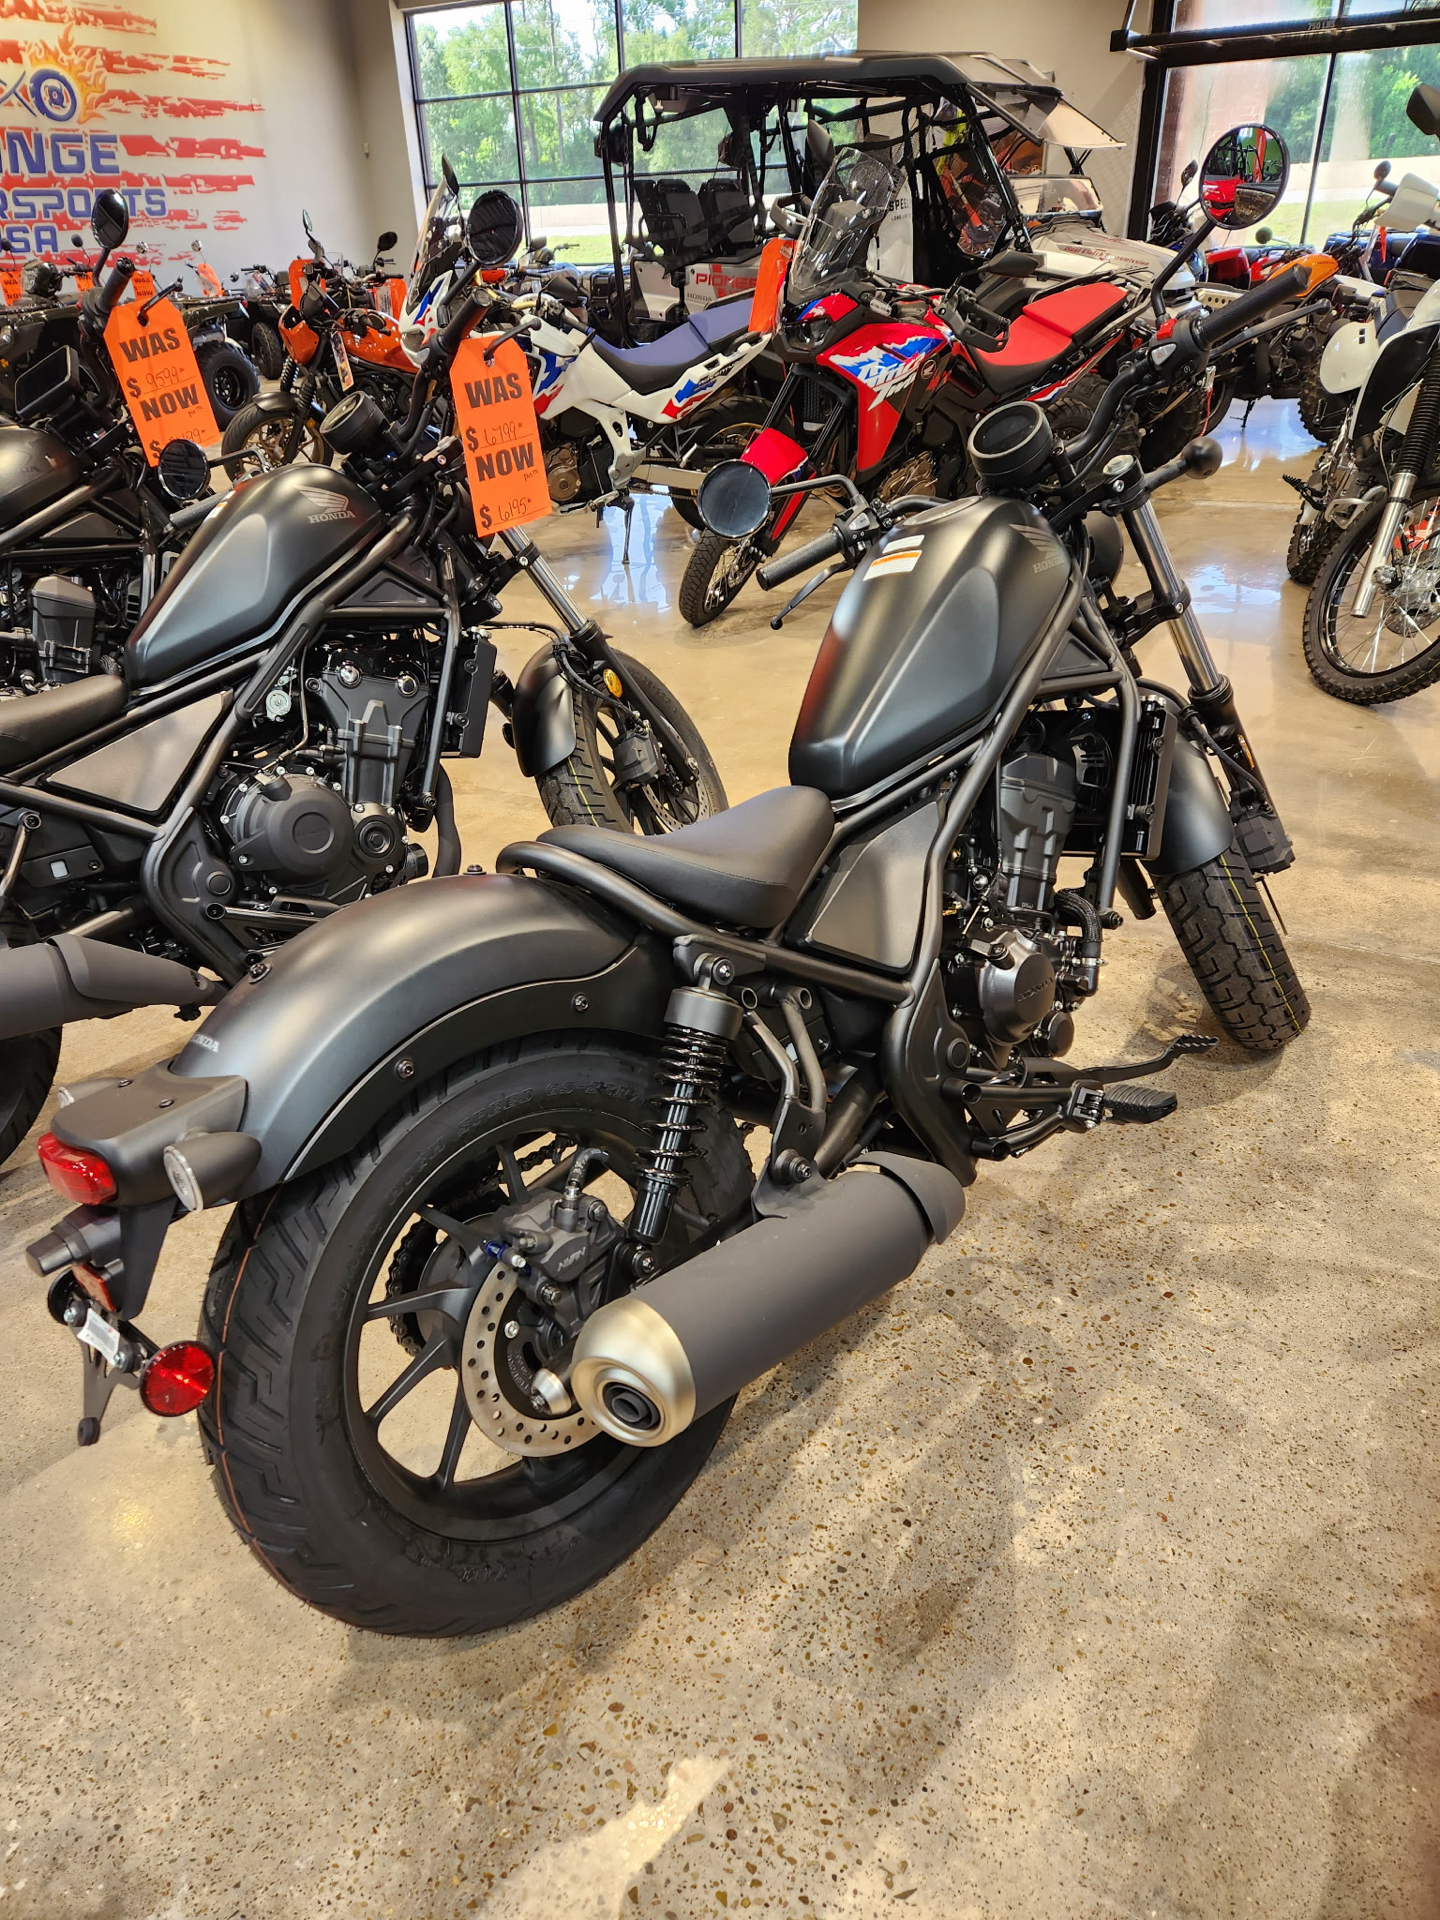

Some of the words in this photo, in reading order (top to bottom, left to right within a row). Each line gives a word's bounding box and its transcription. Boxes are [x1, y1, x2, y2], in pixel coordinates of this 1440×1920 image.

[0, 132, 120, 174] NGE
[0, 188, 167, 219] SPOTS
[0, 223, 59, 253] SA
[695, 272, 757, 291] PIONEE
[119, 328, 181, 363] WAS
[126, 376, 142, 399] $
[464, 373, 523, 409] WAS
[140, 384, 199, 422] NOW
[466, 426, 479, 453] $
[475, 442, 535, 483] NOW
[308, 511, 356, 524] HONDA
[479, 504, 492, 530] $
[189, 1033, 220, 1053] ONDA
[458, 1087, 533, 1137] SPEED
